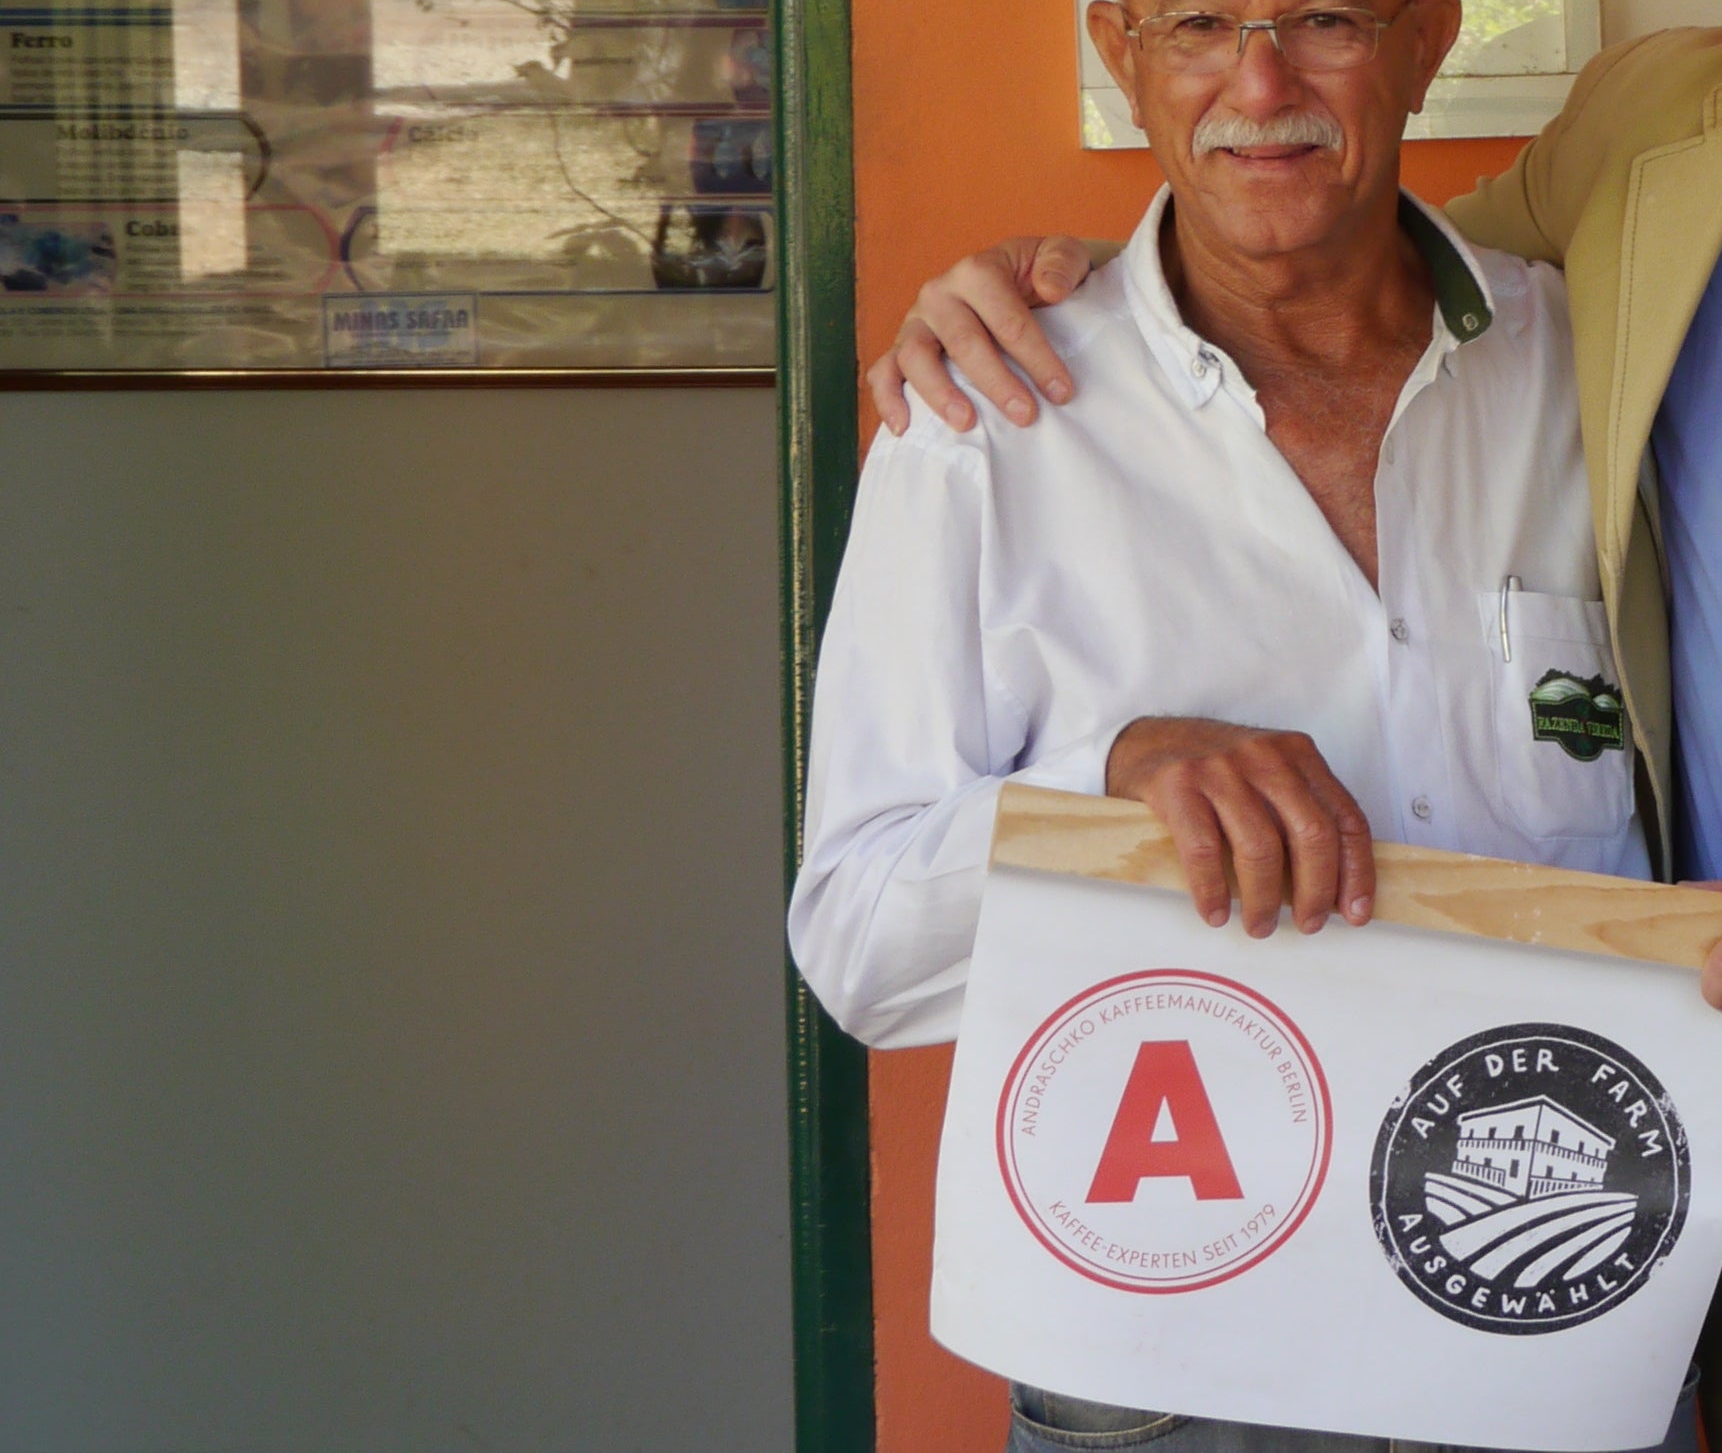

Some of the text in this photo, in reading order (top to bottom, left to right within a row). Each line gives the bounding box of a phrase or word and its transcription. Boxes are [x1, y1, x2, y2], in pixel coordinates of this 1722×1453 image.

[10, 32, 73, 48] Ferro
[1021, 994, 1308, 1137] ANDRASCHKO KAFFEEMANUFAKTUR BERLIN
[1411, 1048, 1663, 1158] AUF DER FARM
[1084, 1039, 1246, 1204] A
[1049, 1200, 1276, 1269] KAFFEE-EXPERTEN SEIT 1979
[1398, 1212, 1635, 1315] AUSGEWÄHLT
